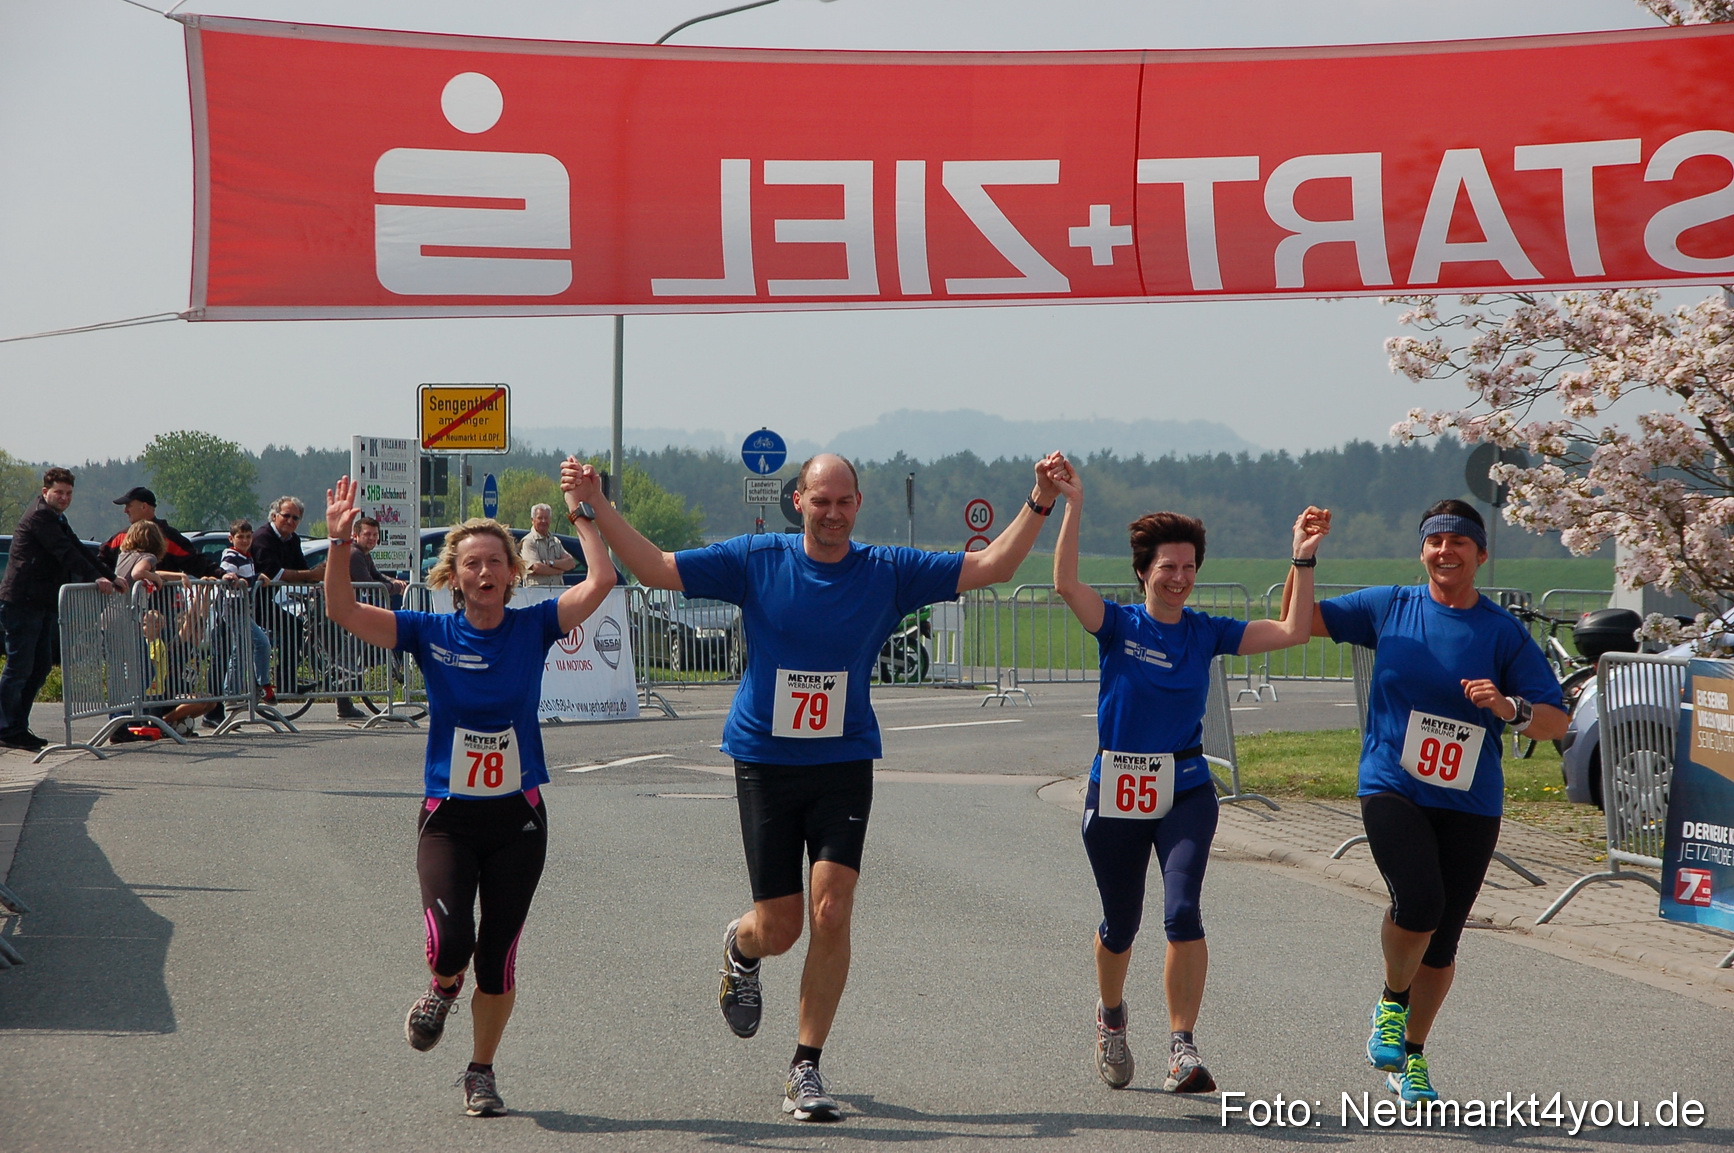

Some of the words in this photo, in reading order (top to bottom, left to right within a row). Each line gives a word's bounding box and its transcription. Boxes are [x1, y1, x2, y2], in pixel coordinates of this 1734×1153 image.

[429, 395, 499, 415] Sengenthal
[438, 417, 454, 425] am
[446, 432, 477, 442] Neumarkt
[367, 484, 381, 502] SHB
[971, 507, 988, 524] 60
[567, 660, 593, 671] MOTORS
[787, 673, 822, 684] MEYER
[787, 682, 822, 690] WERBUNG
[791, 692, 829, 731] 79
[1420, 725, 1456, 738] WERBUNG
[1421, 717, 1456, 732] MEYER
[464, 733, 497, 745] MEYER
[464, 742, 498, 751] WERBUNG
[1113, 754, 1147, 765] MEYER
[1417, 737, 1463, 781] 99
[466, 751, 504, 789] 78
[1113, 763, 1148, 772] WERBUNG
[1115, 774, 1158, 814] 65
[1682, 821, 1709, 840] DER
[1709, 824, 1729, 844] NEUE
[1677, 841, 1711, 862] JETZT
[1678, 872, 1704, 900] 7
